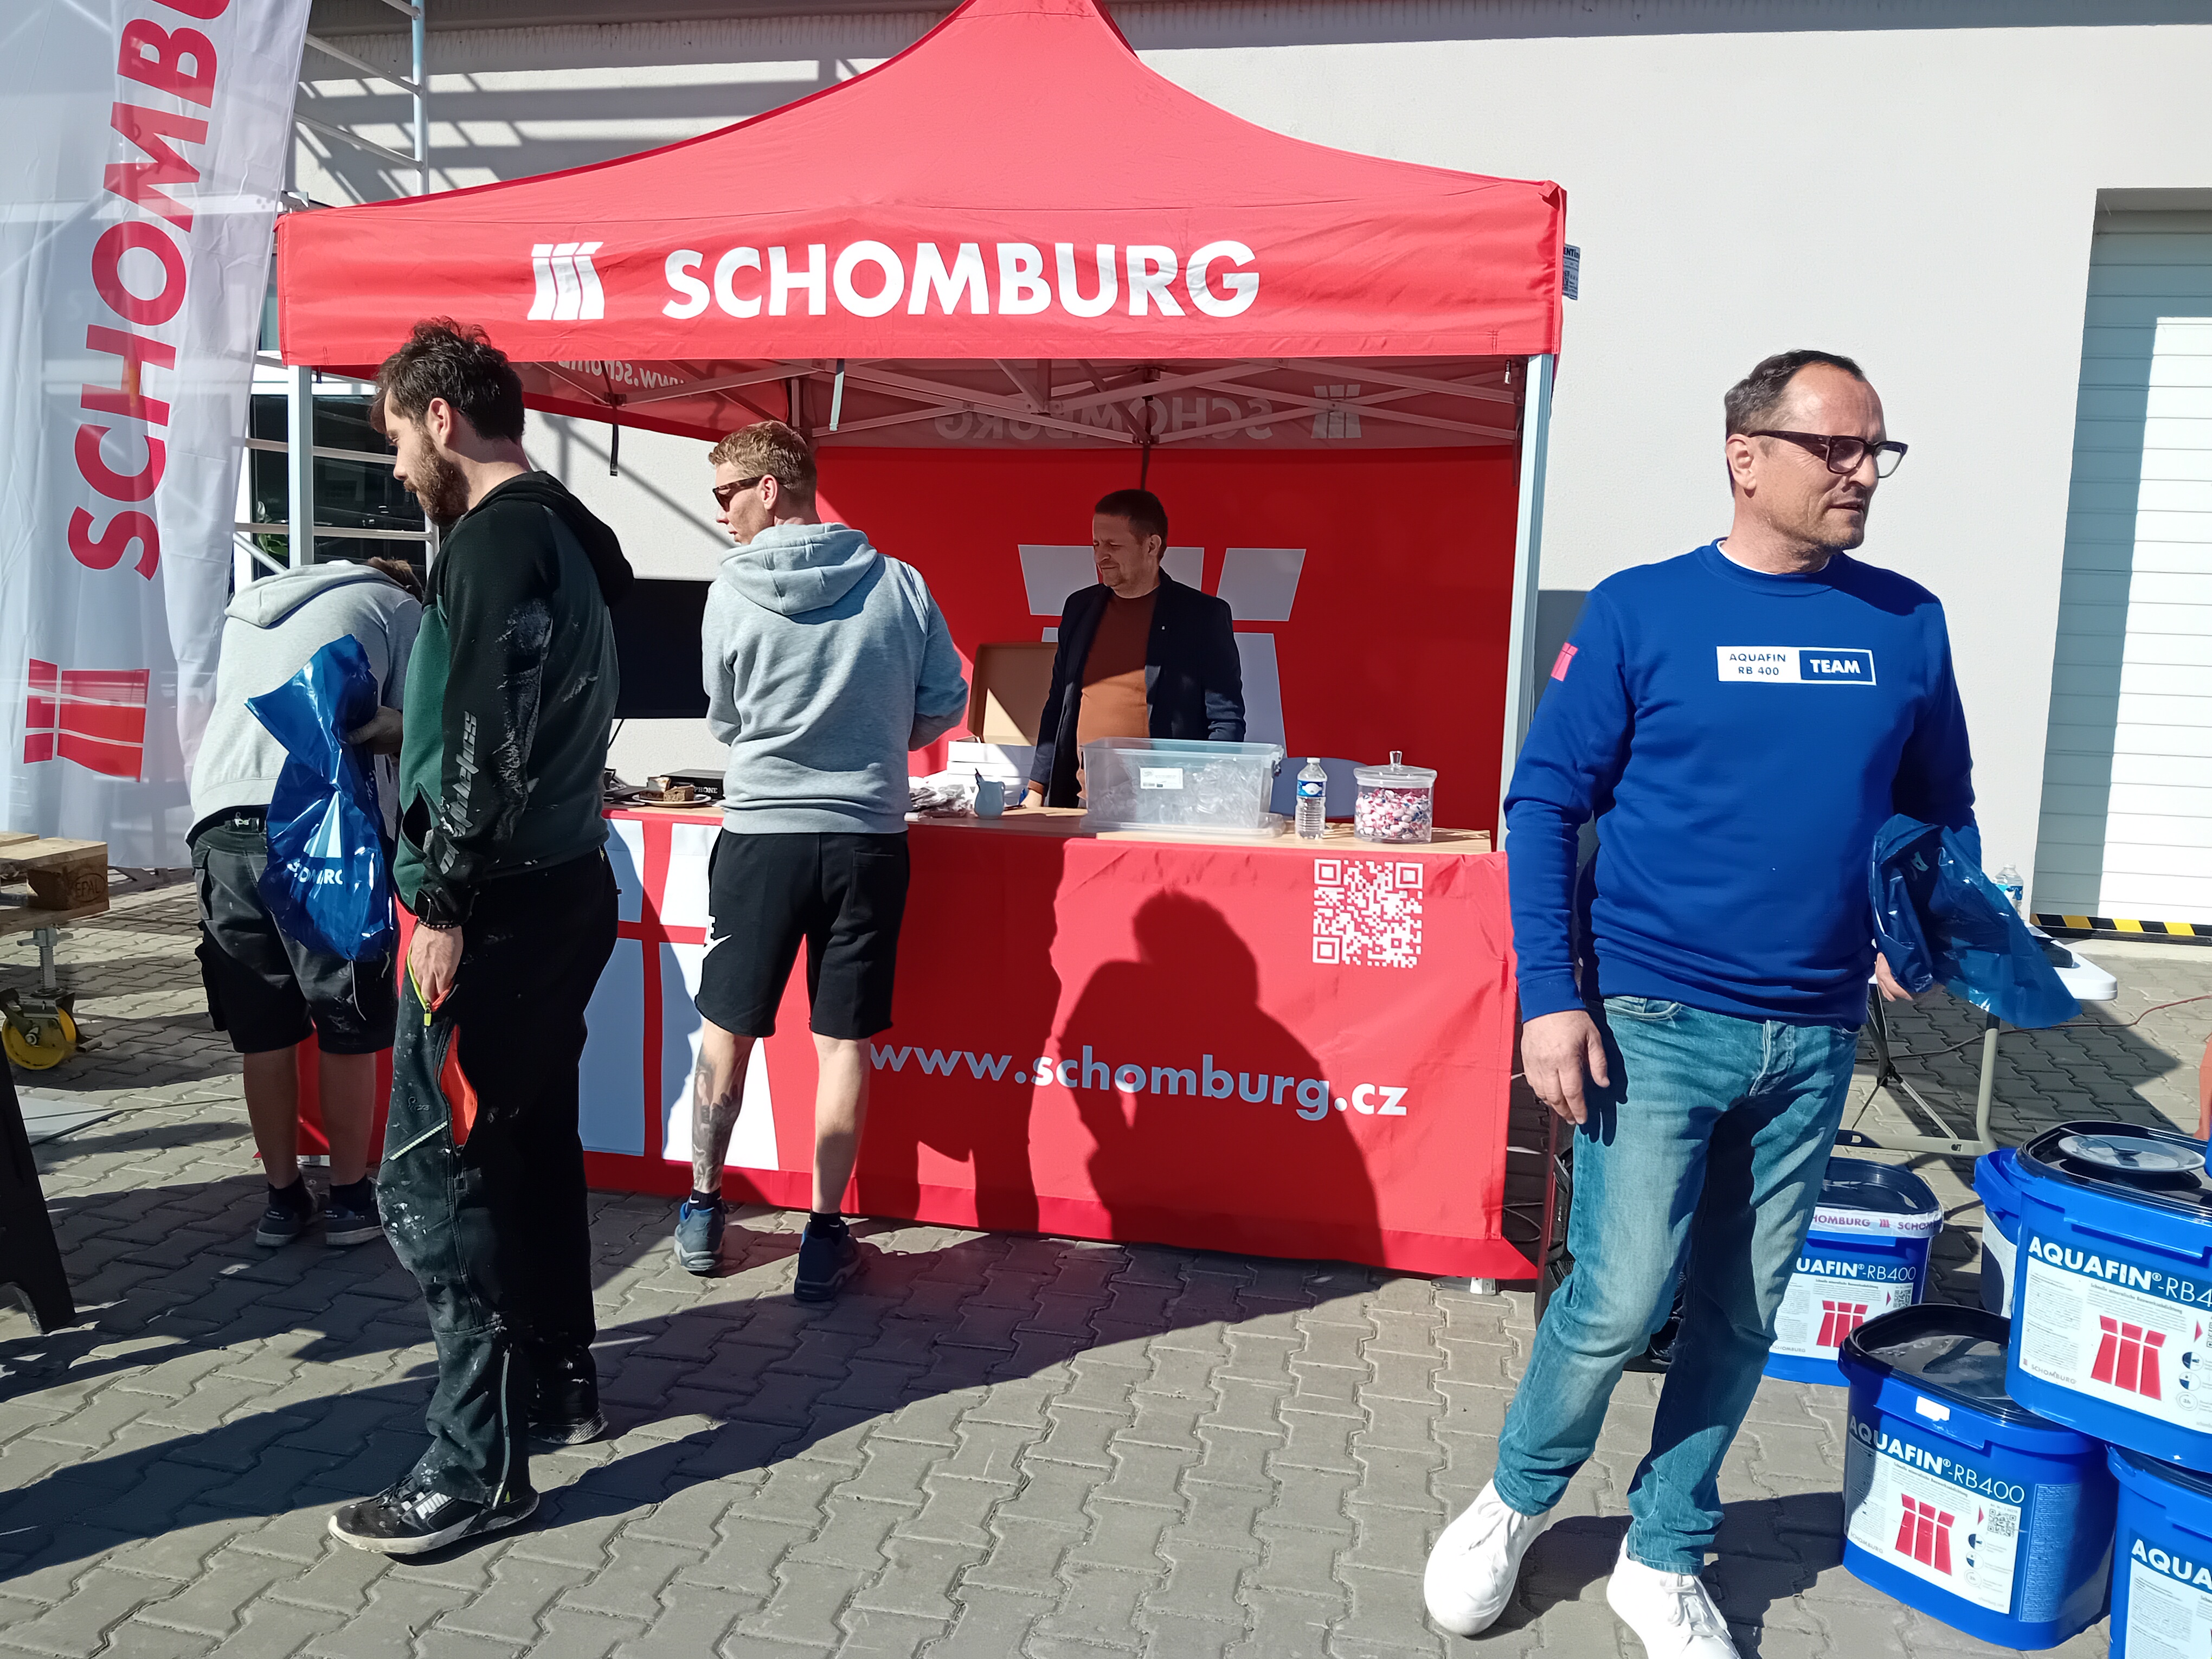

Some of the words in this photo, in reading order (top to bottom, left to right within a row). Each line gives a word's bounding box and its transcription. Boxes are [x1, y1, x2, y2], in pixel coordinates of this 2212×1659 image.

[662, 240, 1260, 320] SCHOMBURG
[68, 0, 230, 581] SCHOMB
[1729, 653, 1786, 663] AQUAFIN
[1810, 659, 1861, 674] TEAM
[1738, 666, 1753, 674] RB
[1758, 666, 1779, 676] 400
[74, 880, 101, 899] EPAL
[870, 1043, 1409, 1121] www.schomburg.cz
[2031, 1364, 2078, 1385] SCHOMBURG
